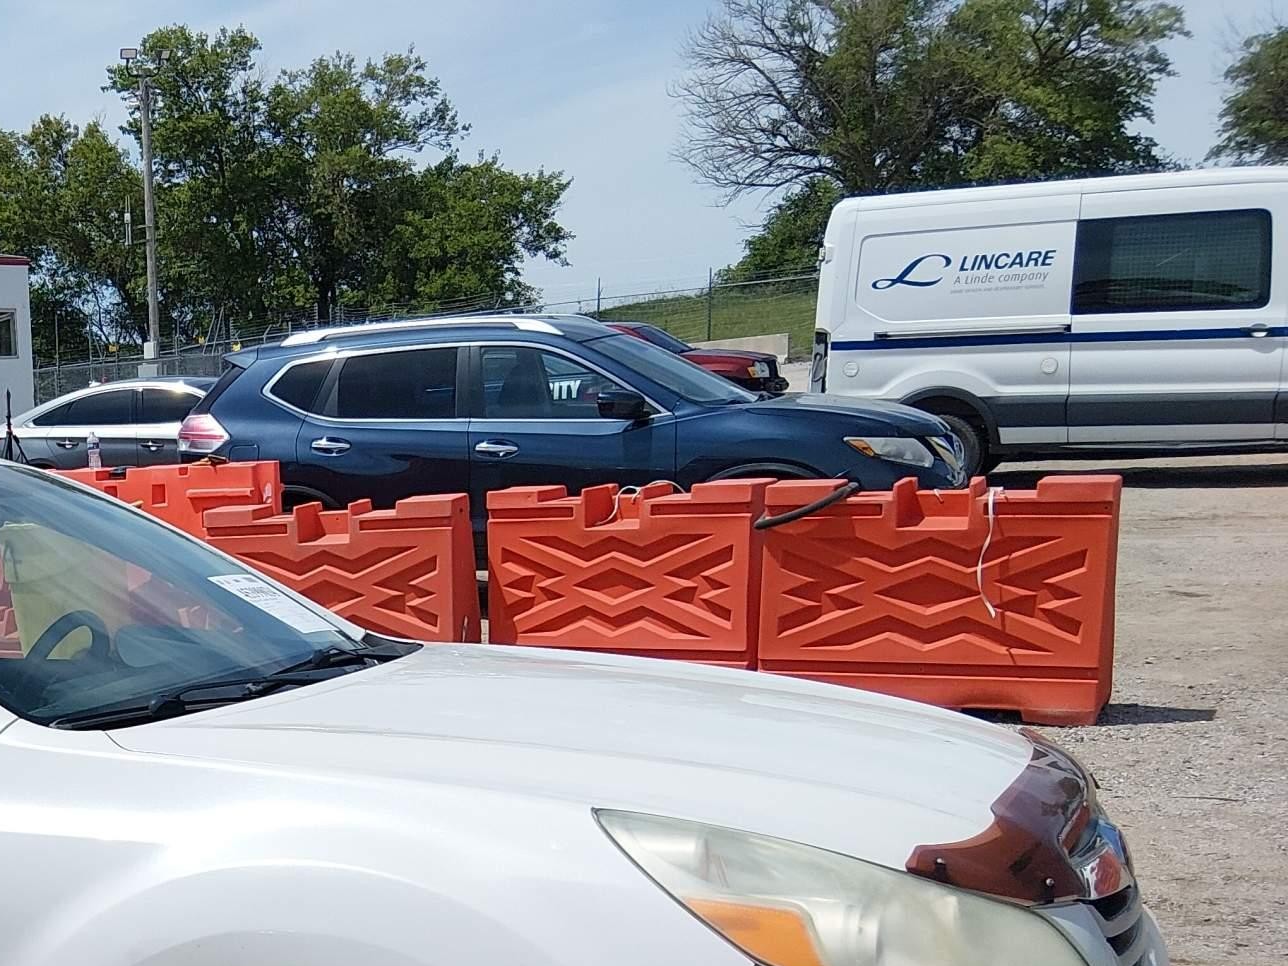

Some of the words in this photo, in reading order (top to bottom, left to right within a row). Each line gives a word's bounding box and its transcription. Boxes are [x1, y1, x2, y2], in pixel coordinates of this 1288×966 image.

[958, 249, 1057, 272] LINCARE
[953, 275, 962, 285] A
[964, 273, 994, 285] Linde
[998, 271, 1049, 284] company
